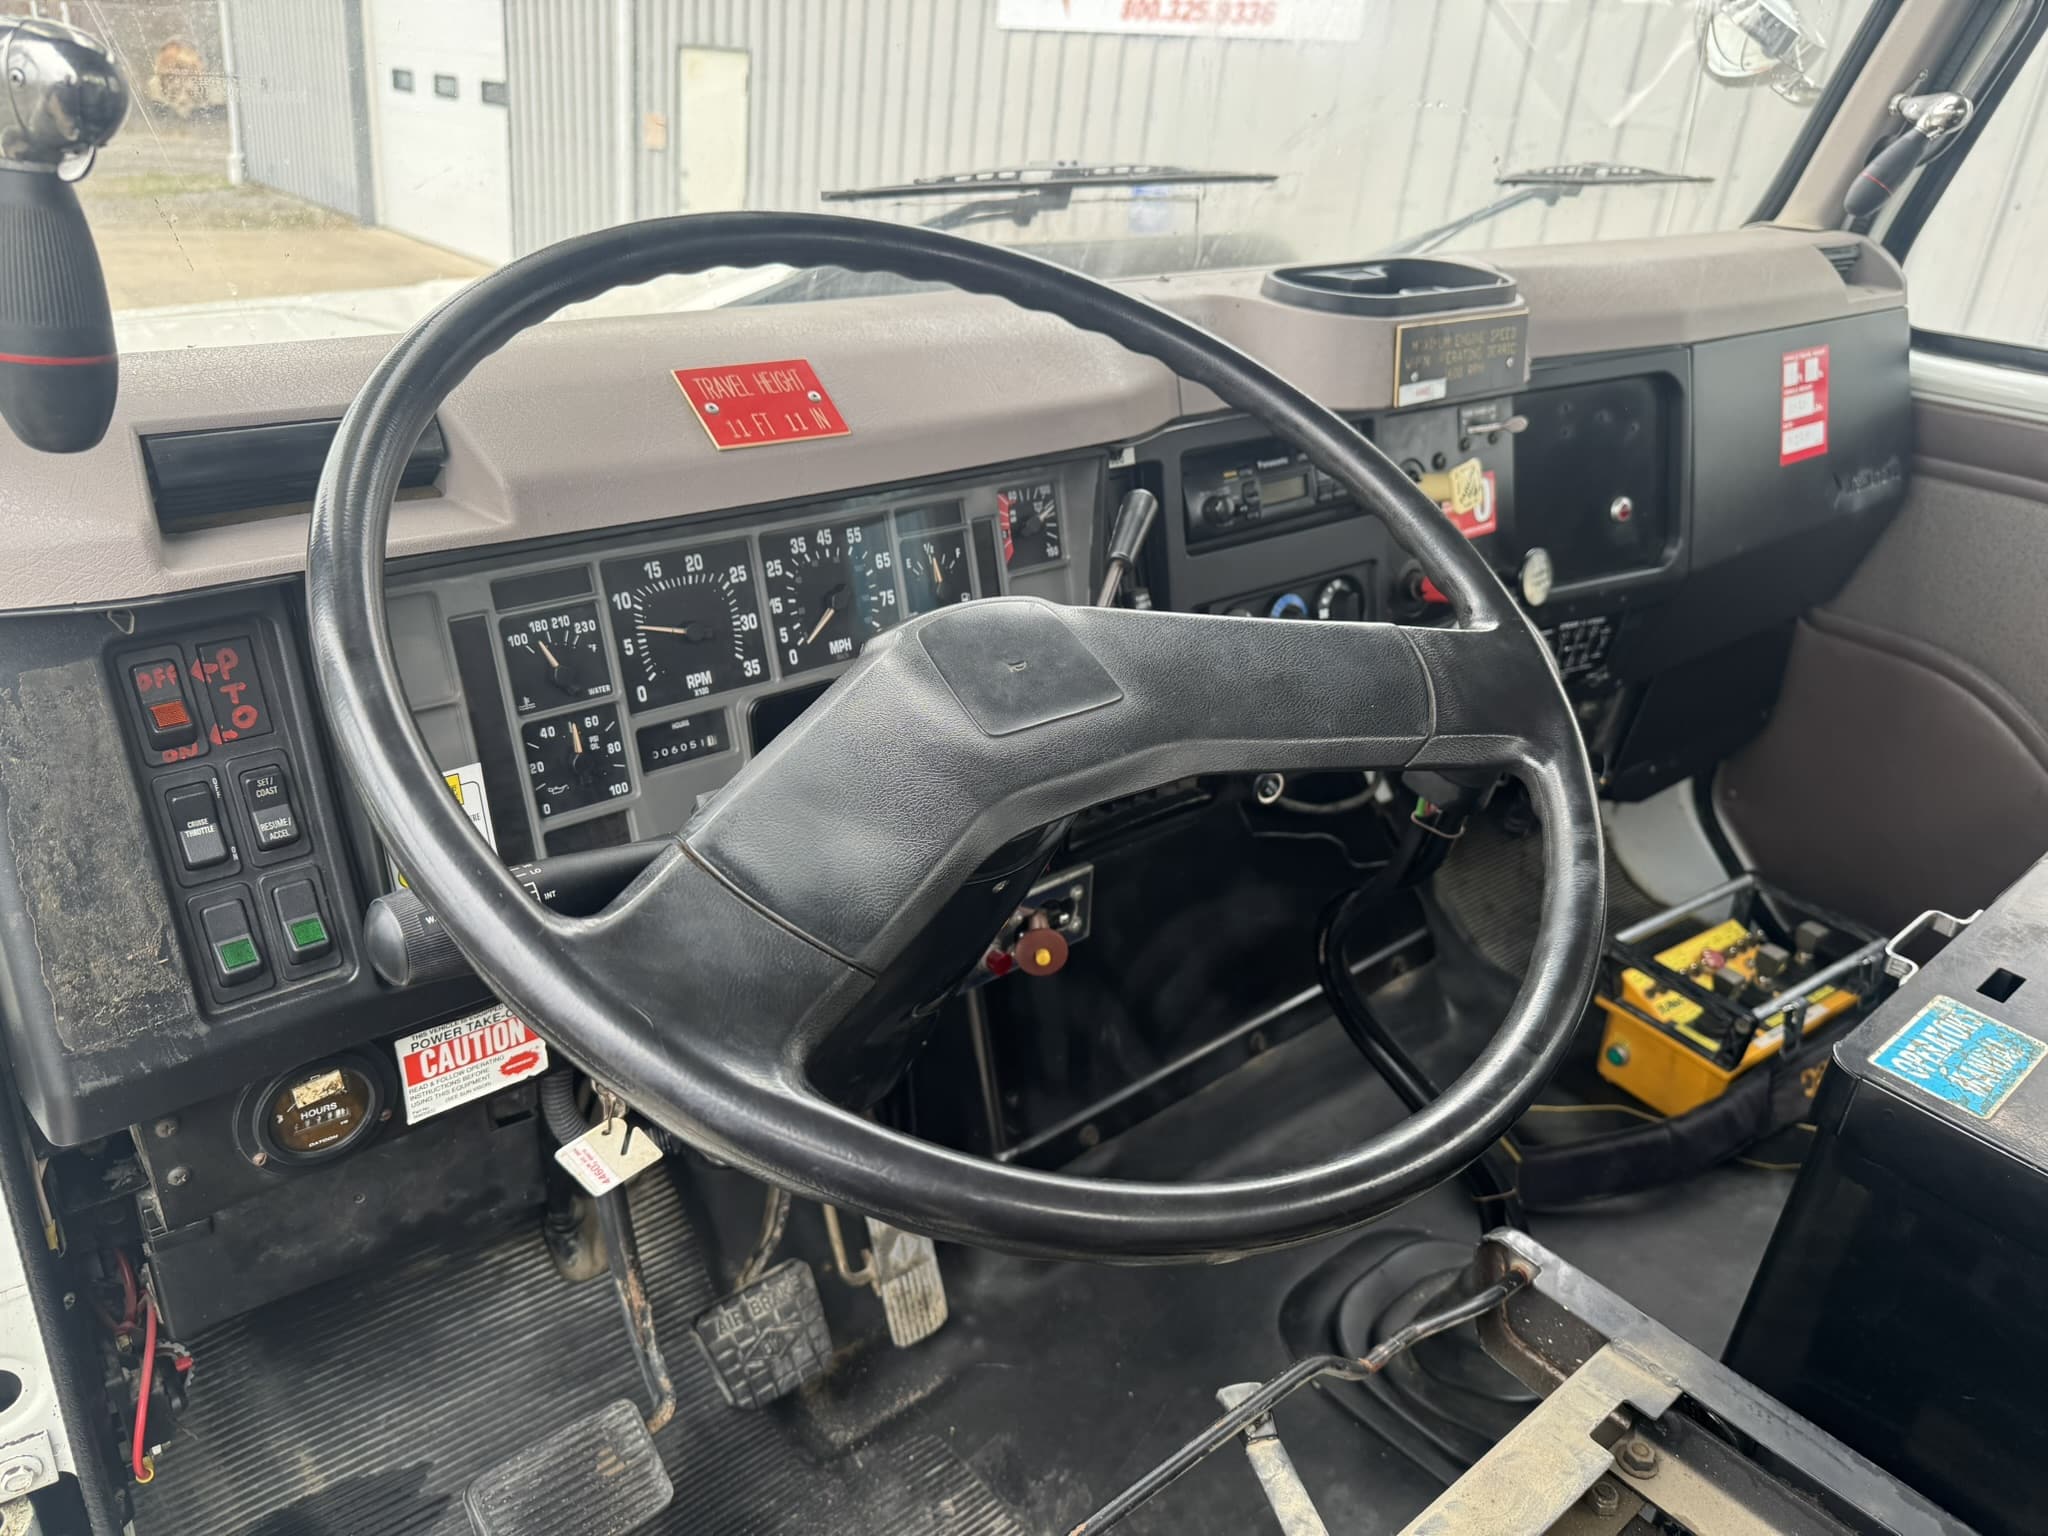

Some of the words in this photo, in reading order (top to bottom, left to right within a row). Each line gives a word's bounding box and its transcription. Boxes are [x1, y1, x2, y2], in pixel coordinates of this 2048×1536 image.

[693, 374, 754, 401] TRAVEL
[752, 368, 806, 395] HEIGHT
[726, 418, 752, 439] 11
[751, 412, 777, 437] FT
[784, 411, 809, 433] 11
[809, 407, 832, 430] IN
[816, 528, 833, 546] 45
[846, 526, 862, 544] 55
[790, 536, 807, 555] 35
[644, 560, 662, 580] 15
[685, 553, 704, 573] 20
[766, 559, 783, 578] 25
[875, 551, 891, 570] 65
[729, 565, 748, 584] 25
[612, 591, 632, 611] 10
[769, 596, 783, 615] 15
[879, 589, 896, 608] 75
[528, 618, 549, 634] 180
[551, 614, 571, 630] 210
[574, 619, 597, 635] 230
[740, 612, 758, 632] 30
[507, 632, 529, 648] 100
[780, 626, 789, 644] 5
[623, 637, 634, 656] 5
[829, 637, 853, 656] MPH
[788, 648, 799, 666] 0
[743, 658, 762, 678] 35
[136, 663, 178, 693] OFF
[686, 669, 713, 690] RPM
[588, 684, 611, 696] WATER
[636, 684, 648, 703] 0
[584, 714, 600, 729] 60
[540, 725, 556, 739] 40
[162, 742, 199, 764] ON
[606, 740, 622, 755] 80
[529, 761, 545, 775] 20
[256, 785, 279, 798] COAST
[609, 781, 629, 796] 100
[543, 803, 552, 815] 0
[184, 824, 217, 838] THROTTLE
[187, 817, 209, 829] CRUISE
[269, 829, 292, 841] ACCEL
[530, 867, 542, 876] LO
[544, 890, 557, 901] INT
[411, 1026, 462, 1052] POWER
[466, 1009, 516, 1033] TAKE-O
[412, 1029, 427, 1041] THIS
[429, 1020, 459, 1035] VEHICLE
[419, 1018, 526, 1079] CAUTION
[409, 1083, 429, 1095] READ
[436, 1071, 466, 1086] FOLLOW
[466, 1055, 505, 1074] OPERATING
[410, 1079, 462, 1102] INSTRUCTIONS
[462, 1067, 490, 1083] BEFORE
[411, 1096, 434, 1108] USING
[434, 1088, 450, 1100] THIS
[451, 1074, 491, 1095] EQUIPMENT
[300, 1102, 338, 1121] HOURS
[716, 1311, 743, 1338] AIR
